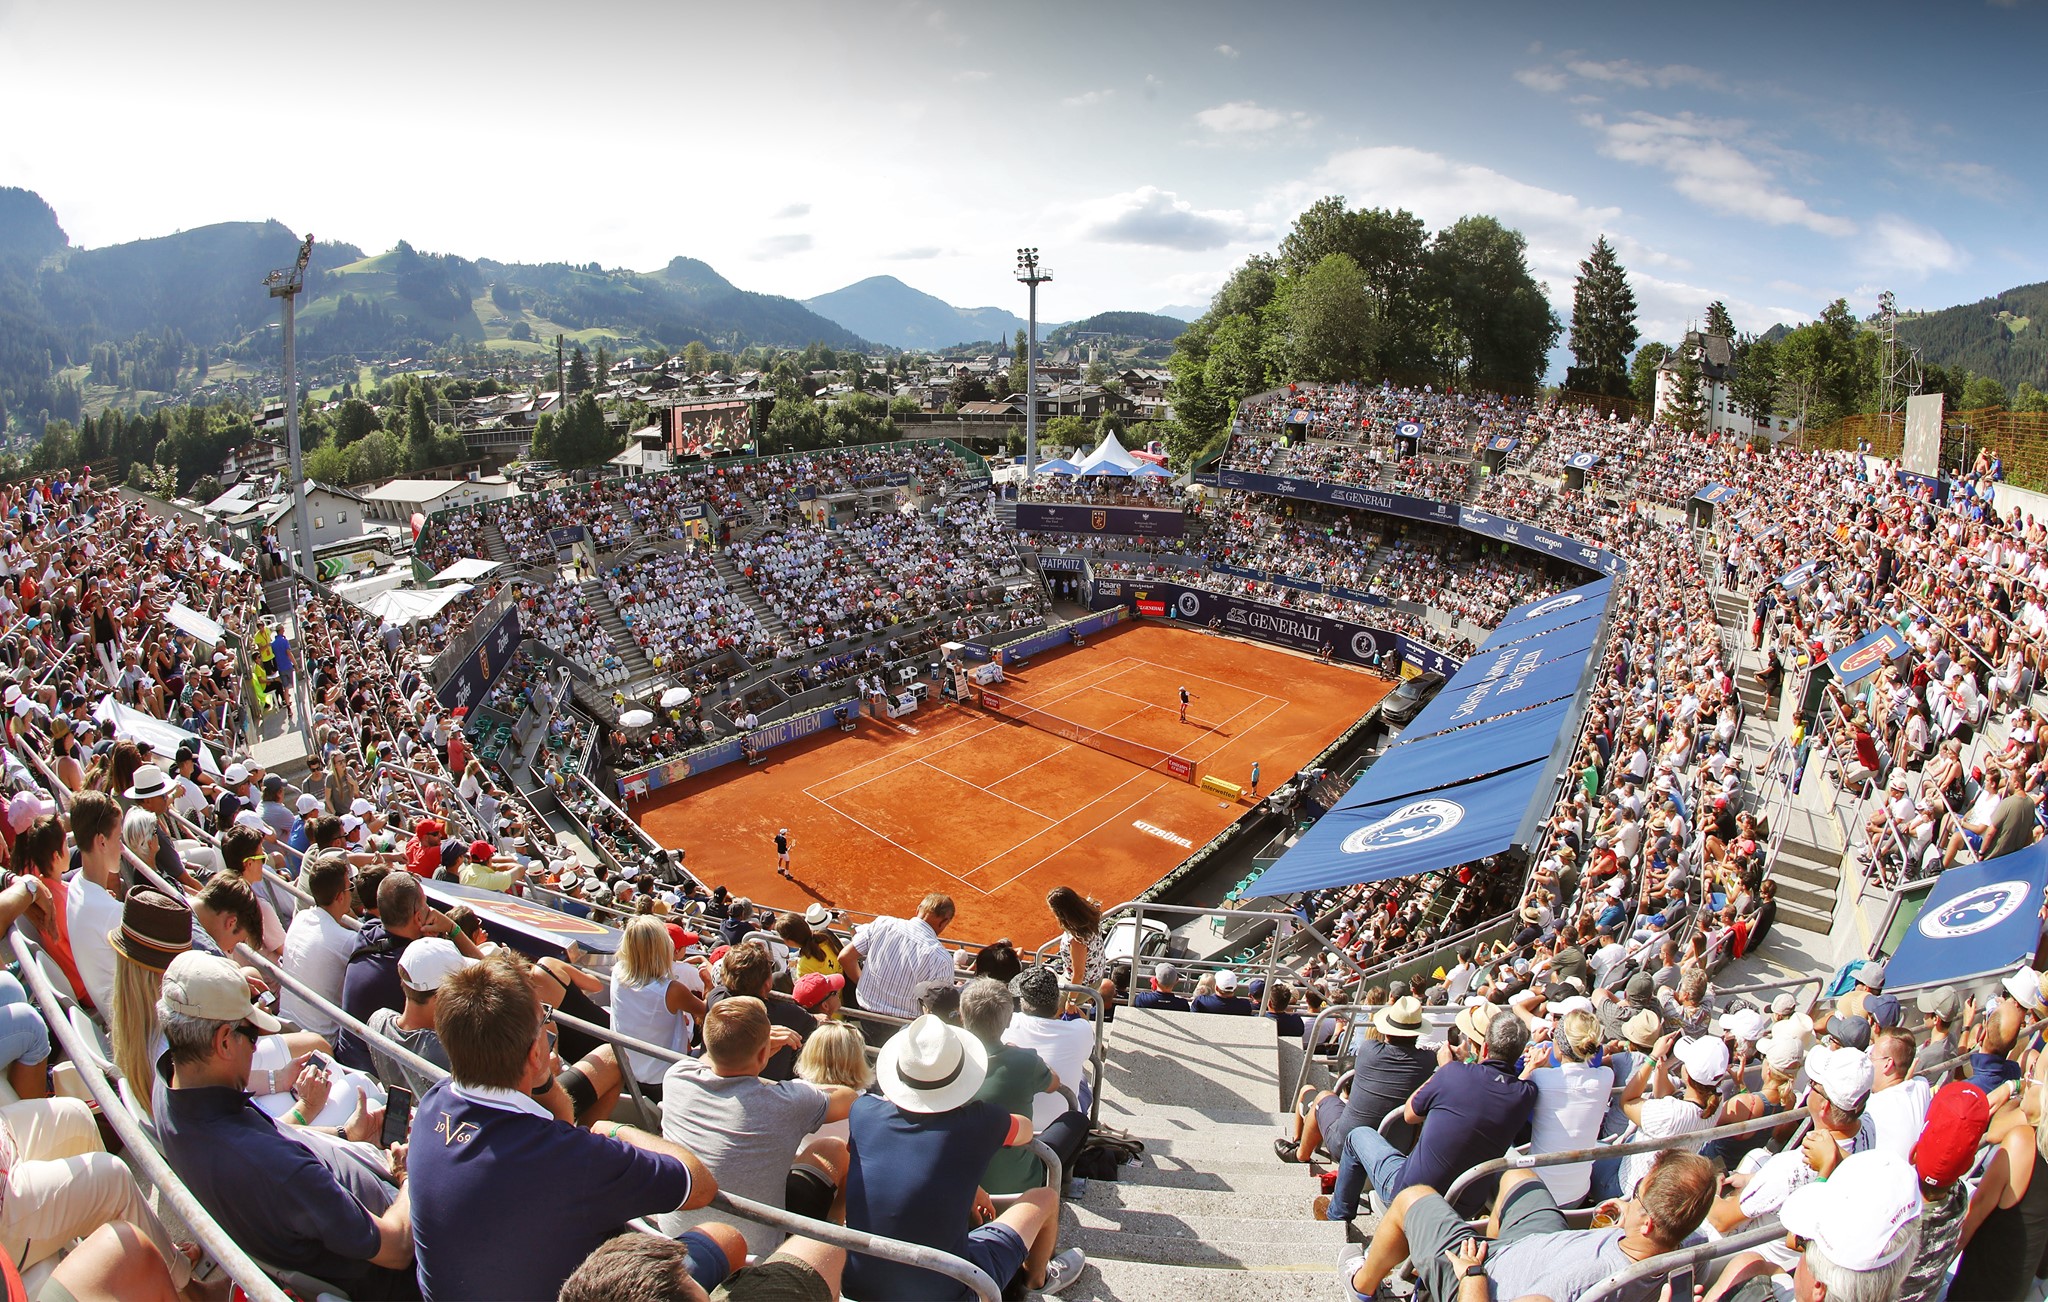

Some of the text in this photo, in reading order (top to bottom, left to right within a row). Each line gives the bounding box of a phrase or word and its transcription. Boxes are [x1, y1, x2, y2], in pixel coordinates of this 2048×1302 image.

[1277, 483, 1296, 493] Zipfer
[1345, 491, 1393, 508] GENERALI
[1534, 535, 1562, 550] octagon
[1579, 548, 1598, 558] ATP
[1041, 558, 1080, 570] #ATPKITZ
[1099, 580, 1121, 589] Haare
[1248, 612, 1322, 642] GENERALI
[789, 713, 821, 738] THIEM
[1168, 760, 1188, 771] Emirates
[1201, 782, 1236, 799] interwetten
[1132, 819, 1193, 849] KITZBÜHEL
[434, 1121, 472, 1145] 19 69
